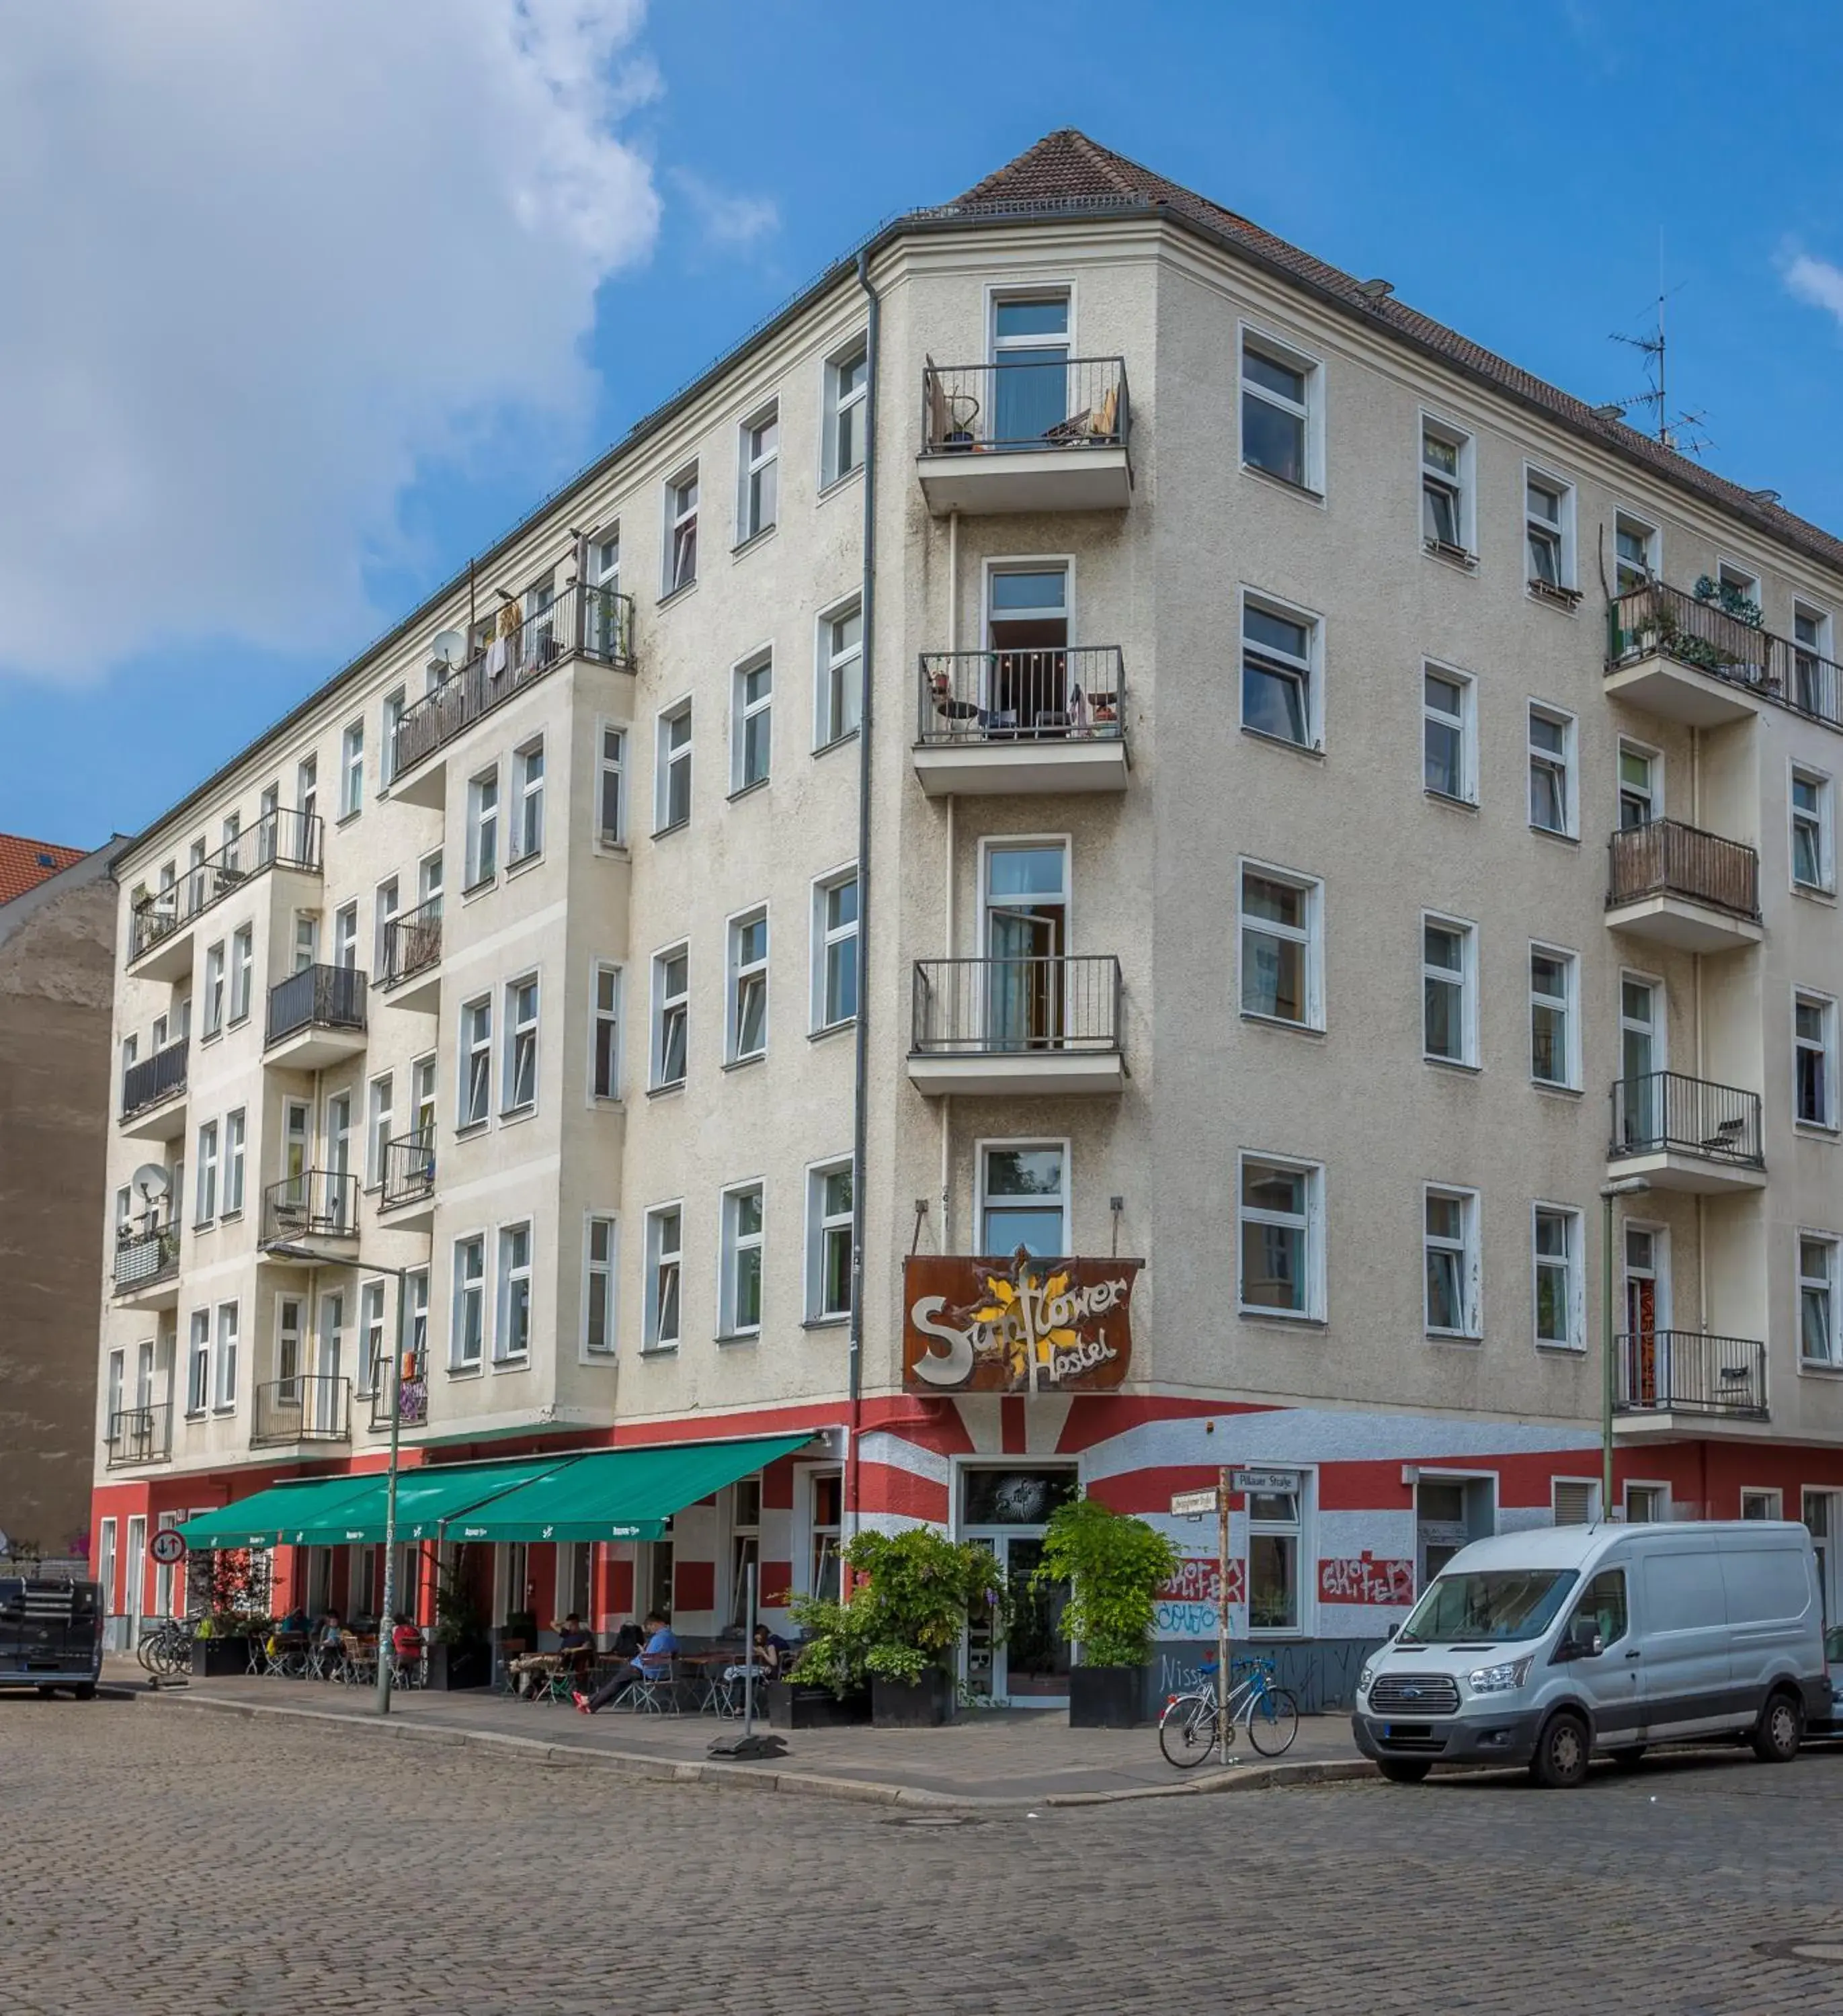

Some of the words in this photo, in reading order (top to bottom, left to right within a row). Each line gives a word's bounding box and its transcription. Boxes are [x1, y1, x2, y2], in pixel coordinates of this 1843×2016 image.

[911, 1273, 1128, 1391] Sunflower
[1029, 1328, 1118, 1391] Hostel
[1269, 1475, 1293, 1490] Straße
